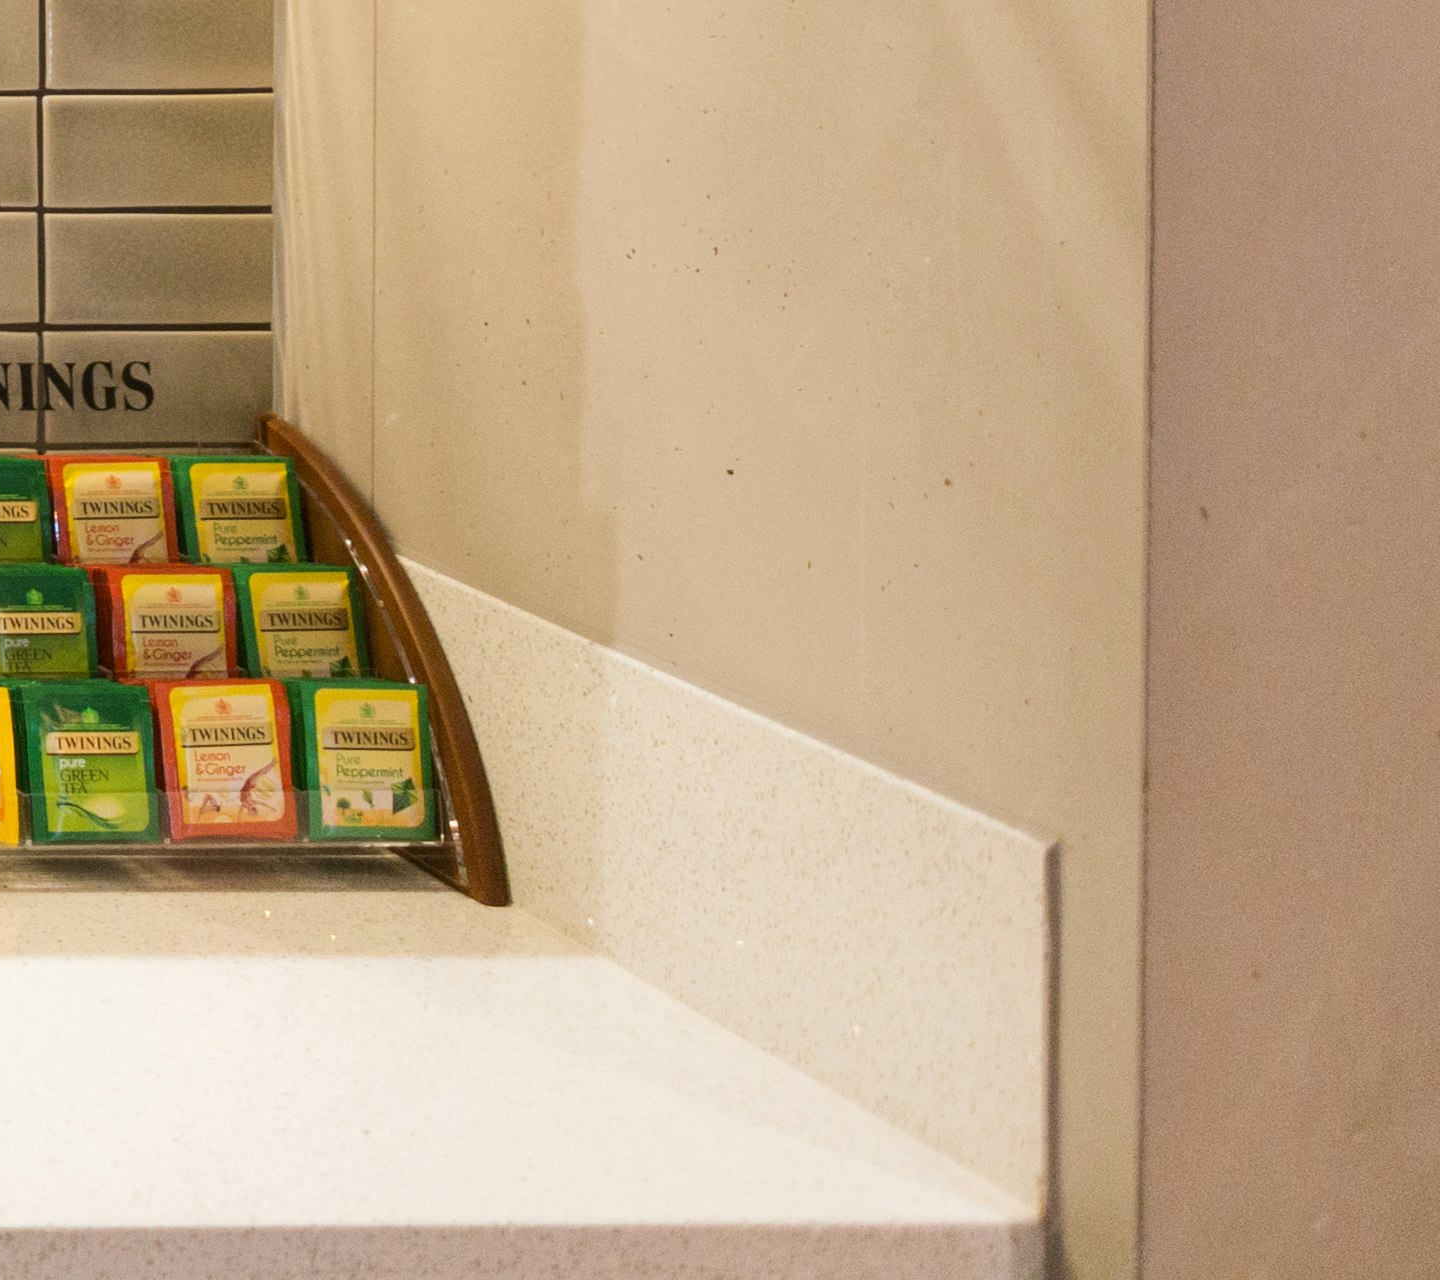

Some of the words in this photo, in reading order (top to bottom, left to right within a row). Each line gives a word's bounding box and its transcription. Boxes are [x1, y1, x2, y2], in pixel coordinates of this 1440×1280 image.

[79, 500, 154, 515] TWININGS
[207, 501, 280, 515] TWININGS
[85, 523, 120, 533] Lemon
[95, 534, 135, 547] Ginger
[214, 534, 278, 547] Peppermint
[2, 617, 75, 631] TWININGS
[138, 615, 214, 629] TWININGS
[267, 612, 342, 627] TWININGS
[142, 636, 178, 648] Lemon
[5, 649, 53, 661] GREEN
[152, 648, 192, 661] Ginger
[274, 646, 341, 659] Peppermint
[189, 726, 266, 742] TWININGS
[332, 730, 409, 746] TWININGS
[55, 735, 132, 751] TWININGS
[194, 750, 231, 763] Lemon
[336, 752, 361, 765] Pure
[58, 757, 86, 770] pure
[205, 763, 247, 777] Ginger
[59, 769, 109, 782] GREEN
[336, 765, 404, 779] Peppermint
[62, 782, 89, 794] TEA
